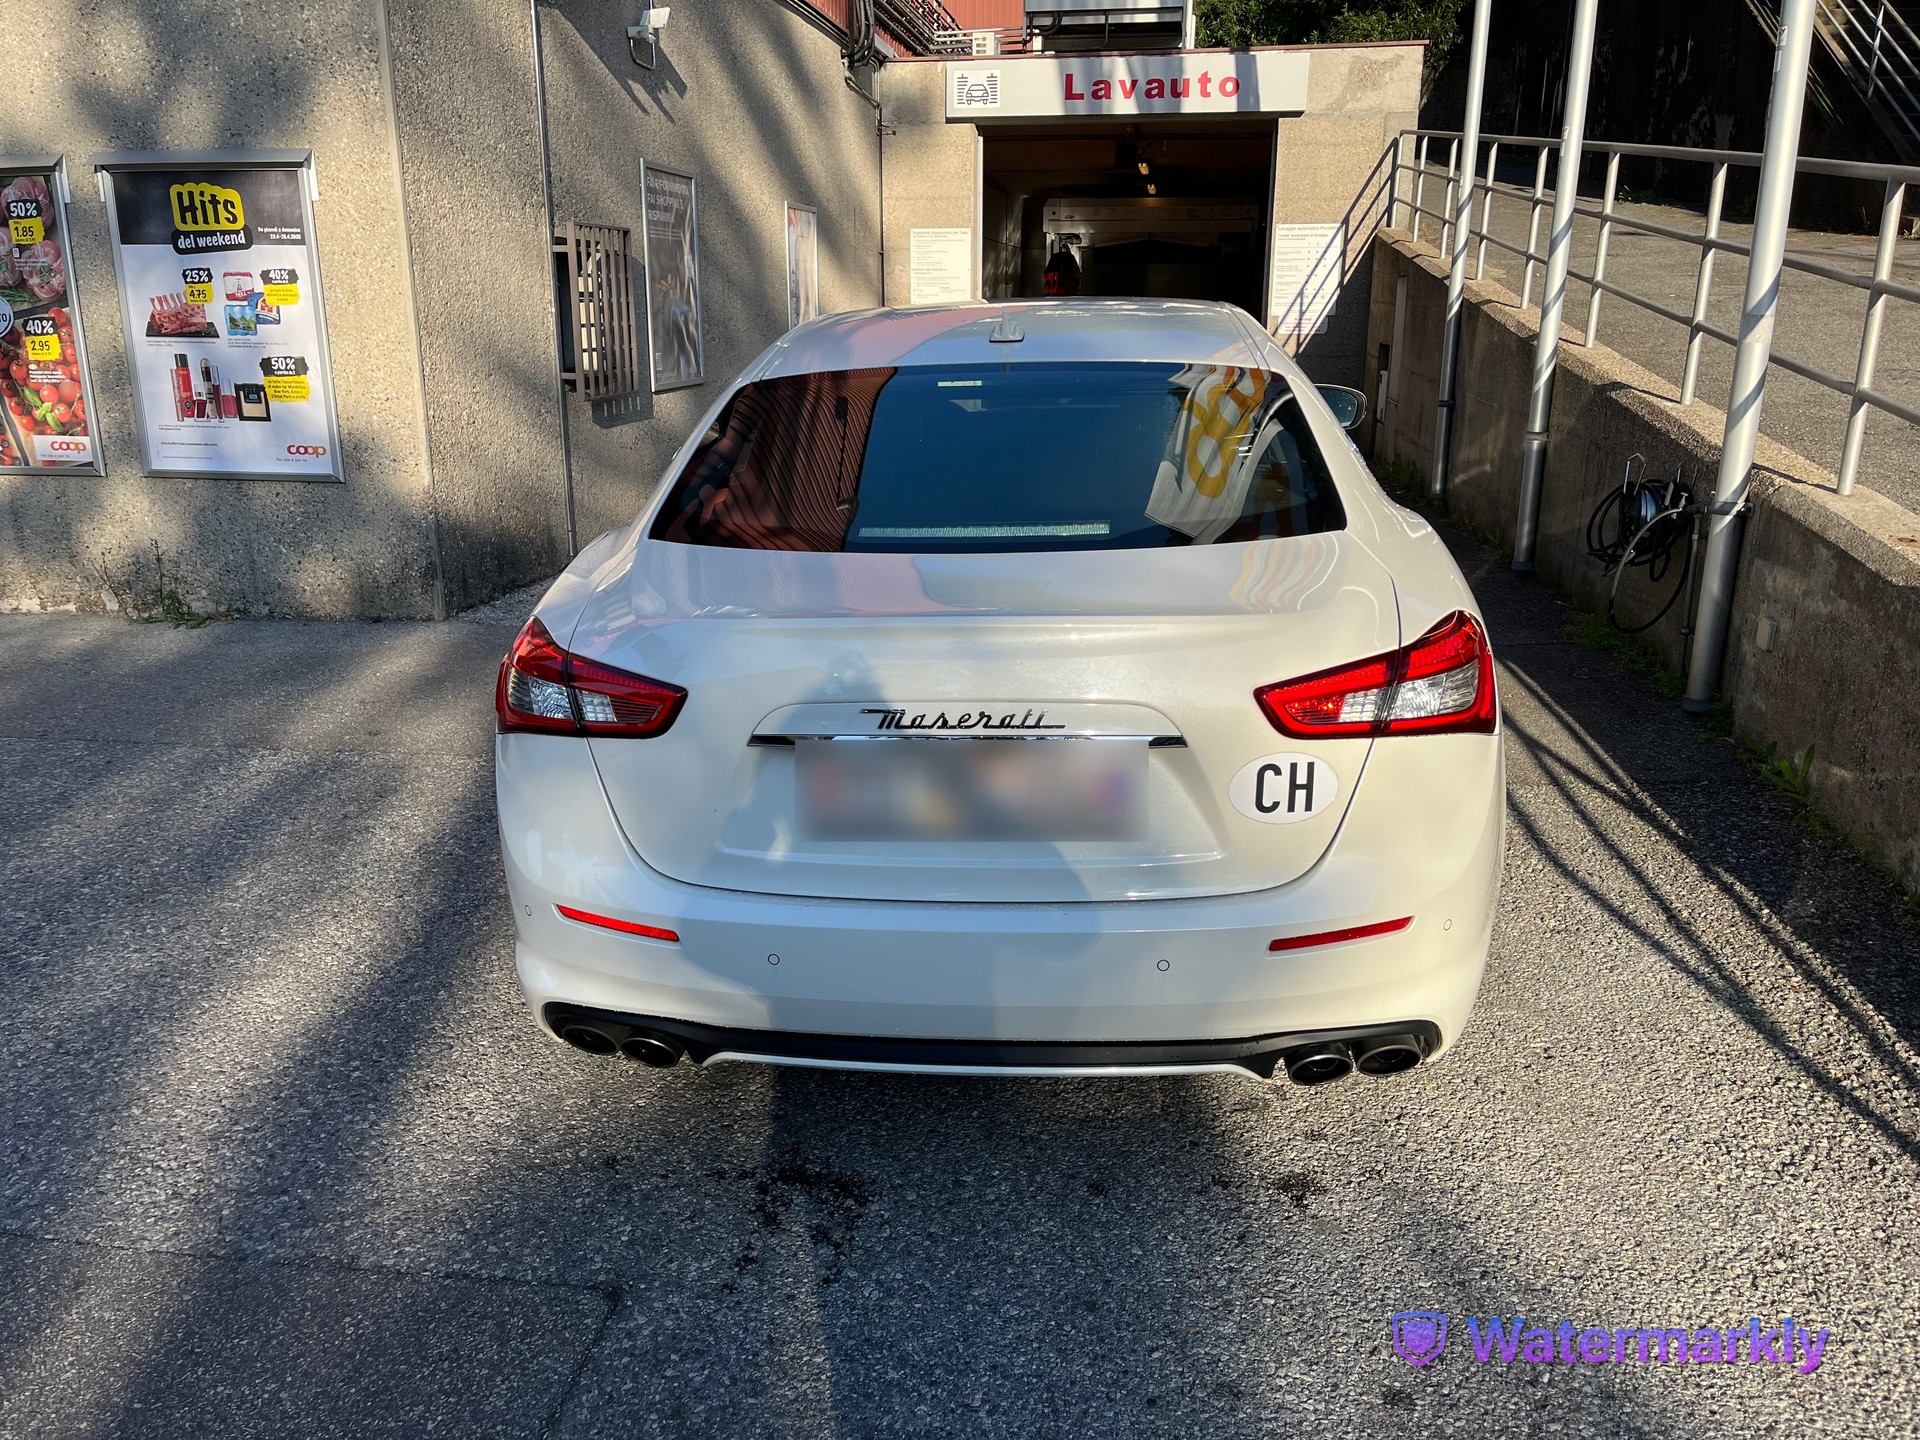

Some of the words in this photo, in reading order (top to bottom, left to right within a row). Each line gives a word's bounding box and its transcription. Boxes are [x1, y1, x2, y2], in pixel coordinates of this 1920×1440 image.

[1064, 71, 1241, 101] Lavauto
[10, 202, 38, 217] 50%
[176, 190, 239, 226] Hits
[13, 225, 35, 238] 1.85
[177, 234, 196, 249] del
[196, 229, 246, 248] weekend
[184, 269, 209, 283] 25%
[268, 269, 289, 281] 40%
[26, 319, 54, 334] 40%
[30, 340, 51, 351] 2.95
[270, 357, 296, 370] 50%
[50, 440, 87, 454] coop
[286, 444, 327, 459] coop
[860, 707, 1066, 730] Maserati
[1254, 761, 1315, 814] CH
